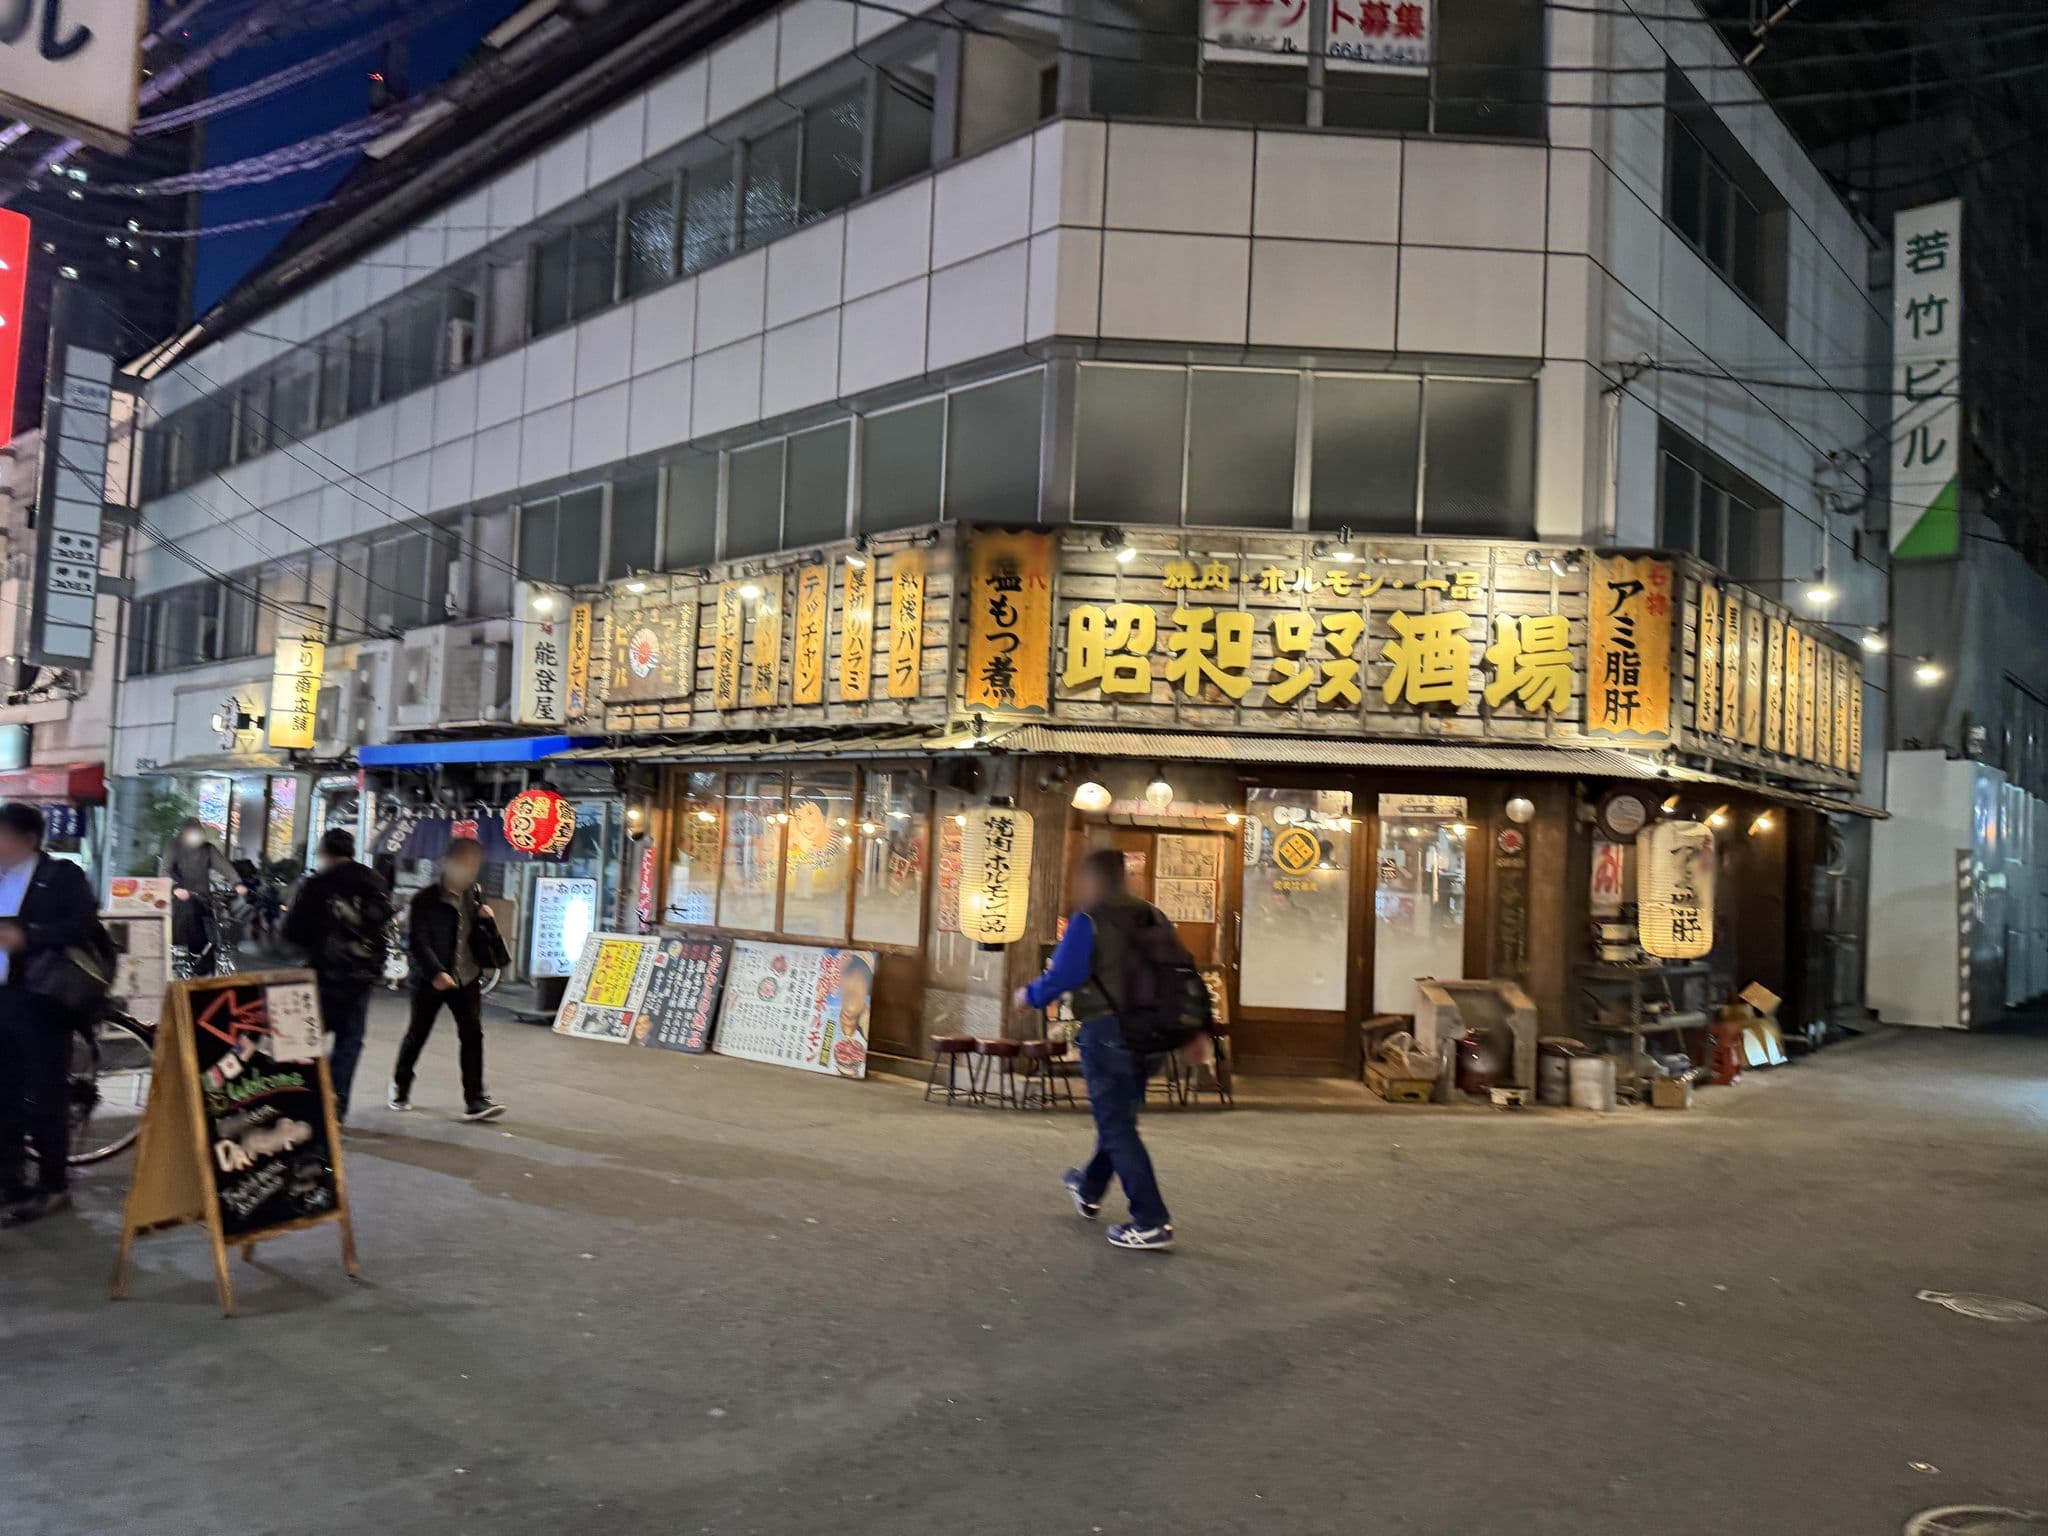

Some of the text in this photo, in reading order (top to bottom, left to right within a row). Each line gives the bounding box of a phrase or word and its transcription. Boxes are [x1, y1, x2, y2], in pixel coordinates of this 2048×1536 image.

[791, 575, 819, 696] テッチャン
[1602, 578, 1645, 726] アミ脂肝
